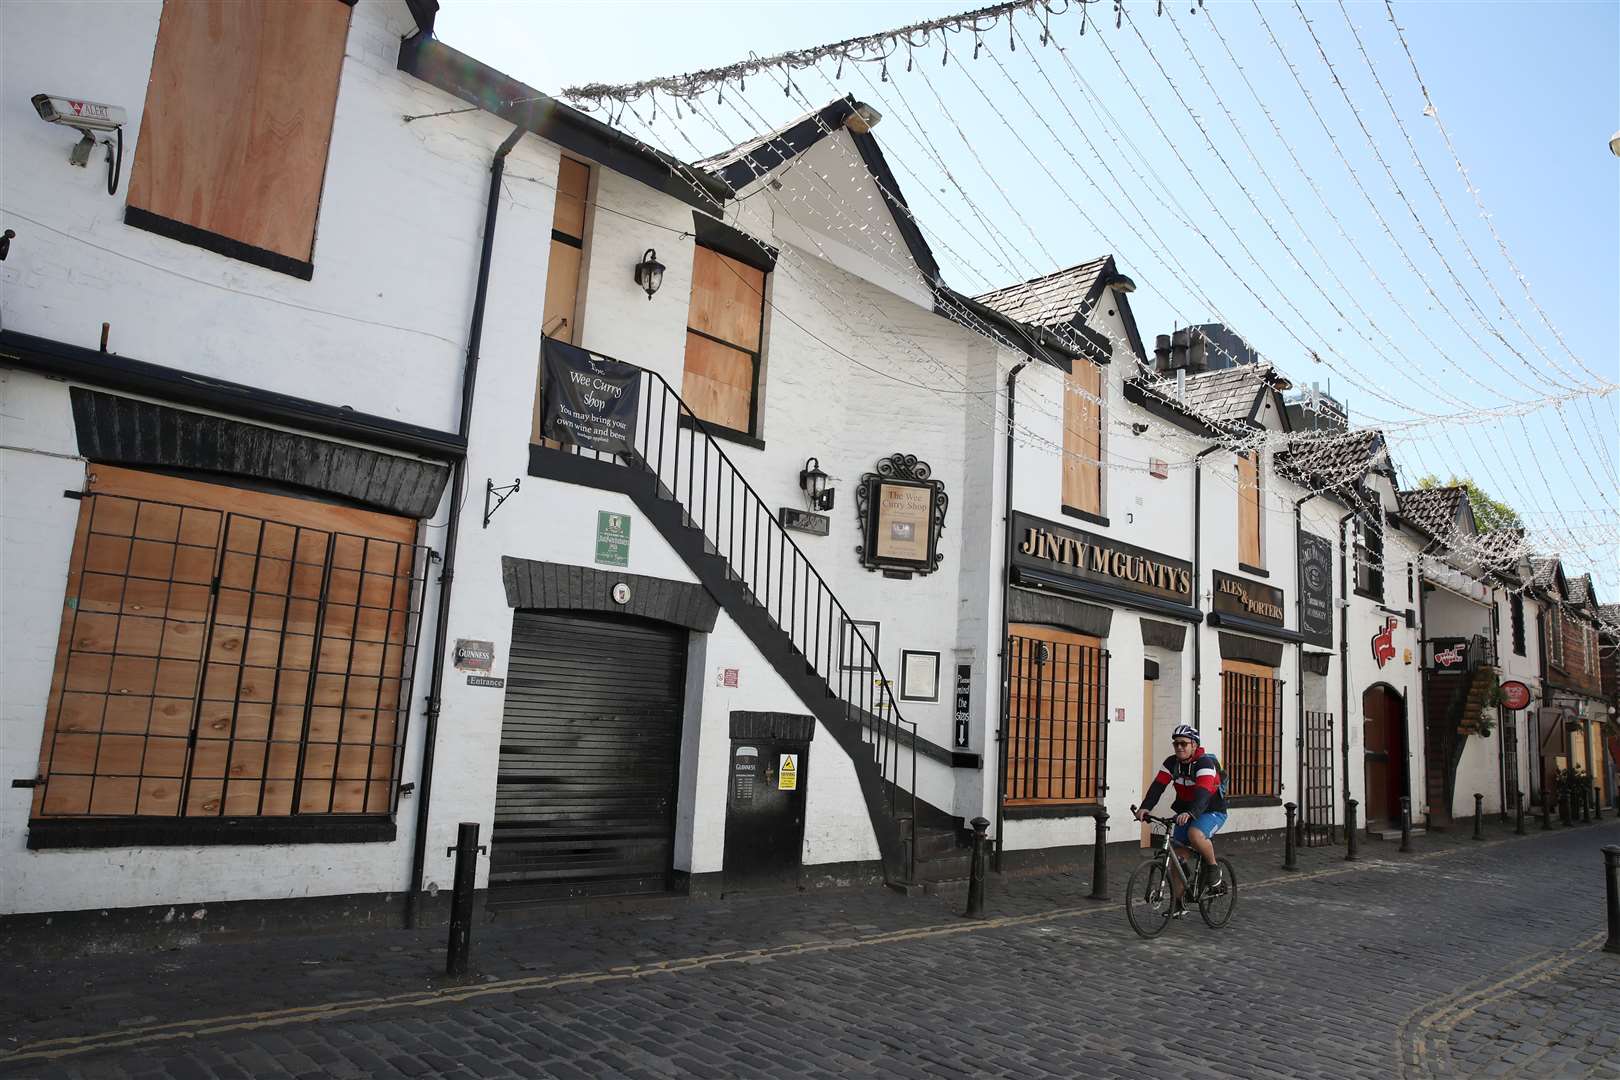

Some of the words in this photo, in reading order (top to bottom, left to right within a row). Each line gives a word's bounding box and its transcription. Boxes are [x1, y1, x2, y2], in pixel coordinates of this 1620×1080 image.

[570, 371, 591, 386] Wee
[593, 378, 622, 398] Curry
[560, 404, 572, 416] You
[573, 411, 590, 421] may
[591, 413, 611, 427] bring
[612, 420, 626, 430] your
[556, 418, 574, 428] own
[574, 423, 592, 434] wine
[593, 426, 609, 437] and
[888, 491, 904, 500] The
[905, 493, 921, 501] Wee
[882, 500, 904, 509] Curry
[907, 501, 927, 512] Shop
[1219, 579, 1243, 597] ALES
[1242, 590, 1249, 604] &
[1248, 599, 1284, 620] PORTERS
[458, 648, 490, 660] GUINNESS
[470, 677, 504, 687] Entrance
